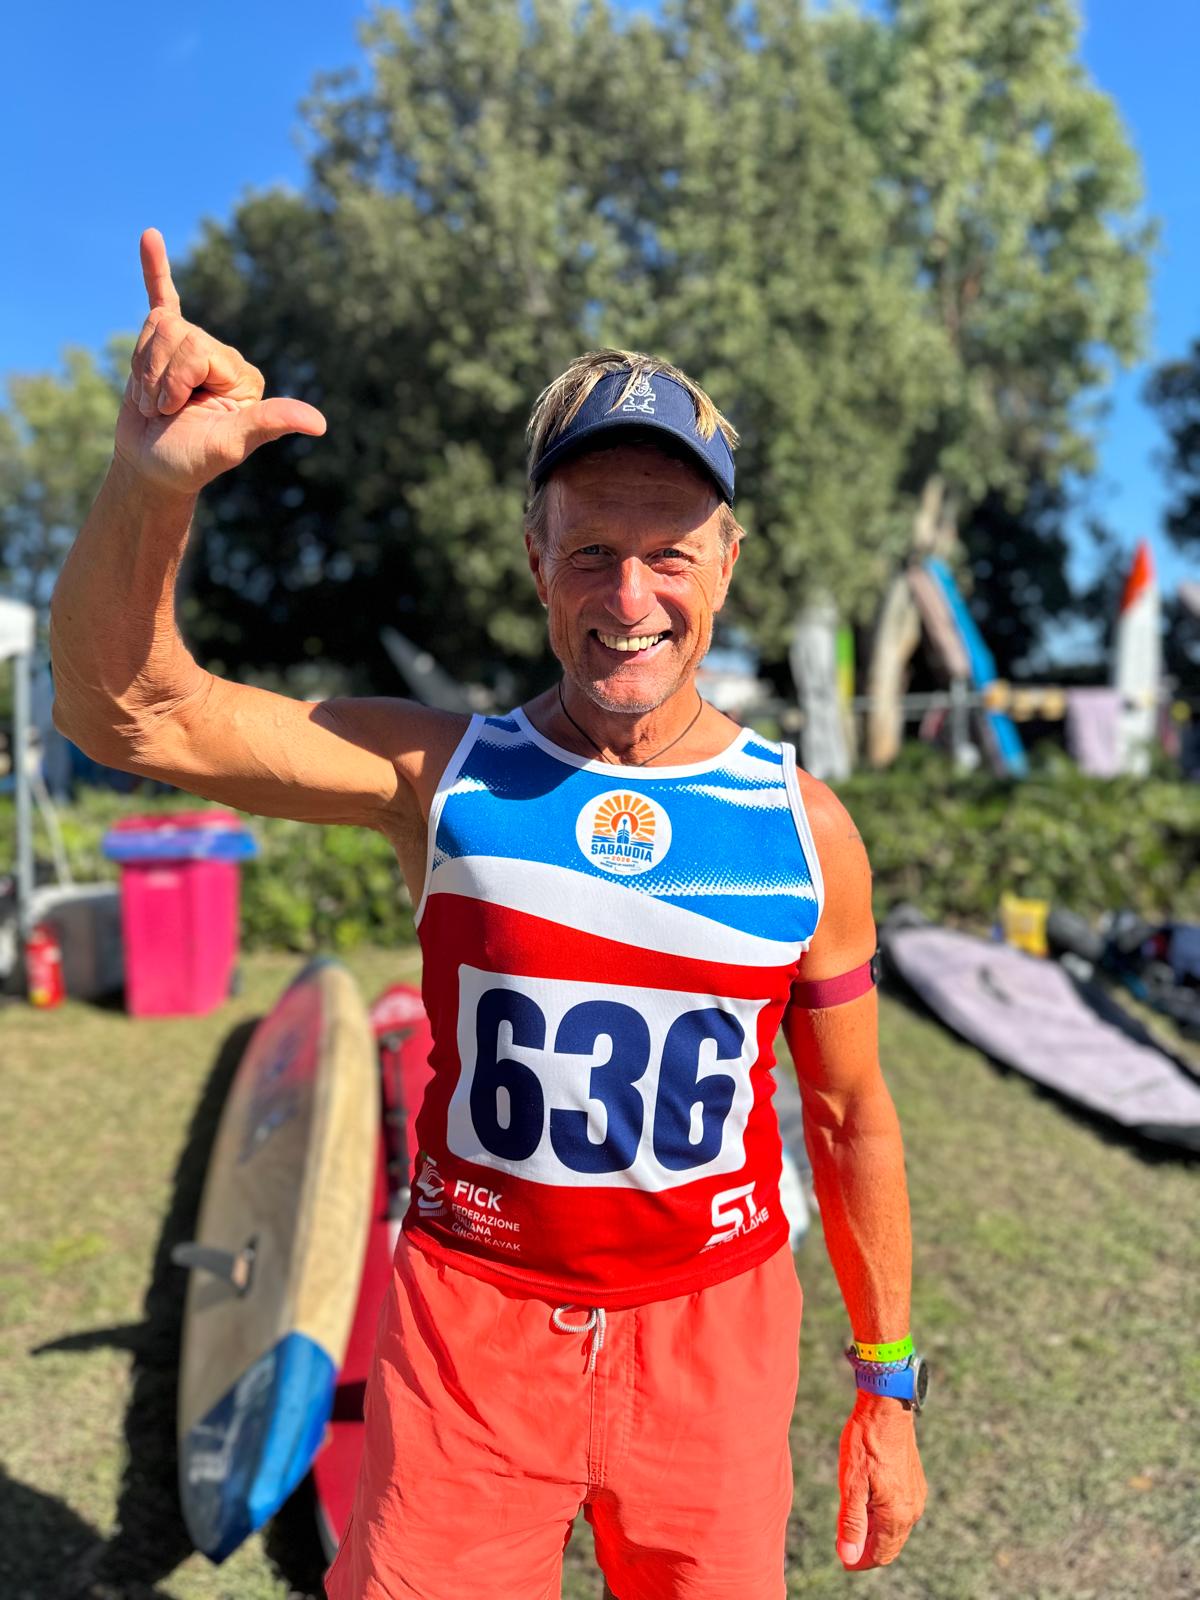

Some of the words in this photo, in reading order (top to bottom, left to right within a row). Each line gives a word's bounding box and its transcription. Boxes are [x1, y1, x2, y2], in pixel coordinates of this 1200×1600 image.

[591, 844, 653, 863] SABAUDIA
[470, 988, 745, 1174] 636
[453, 1179, 502, 1212] FICK
[451, 1203, 521, 1232] FEDERAZIONE
[451, 1222, 482, 1243] CANOA
[484, 1236, 521, 1251] KAYAK
